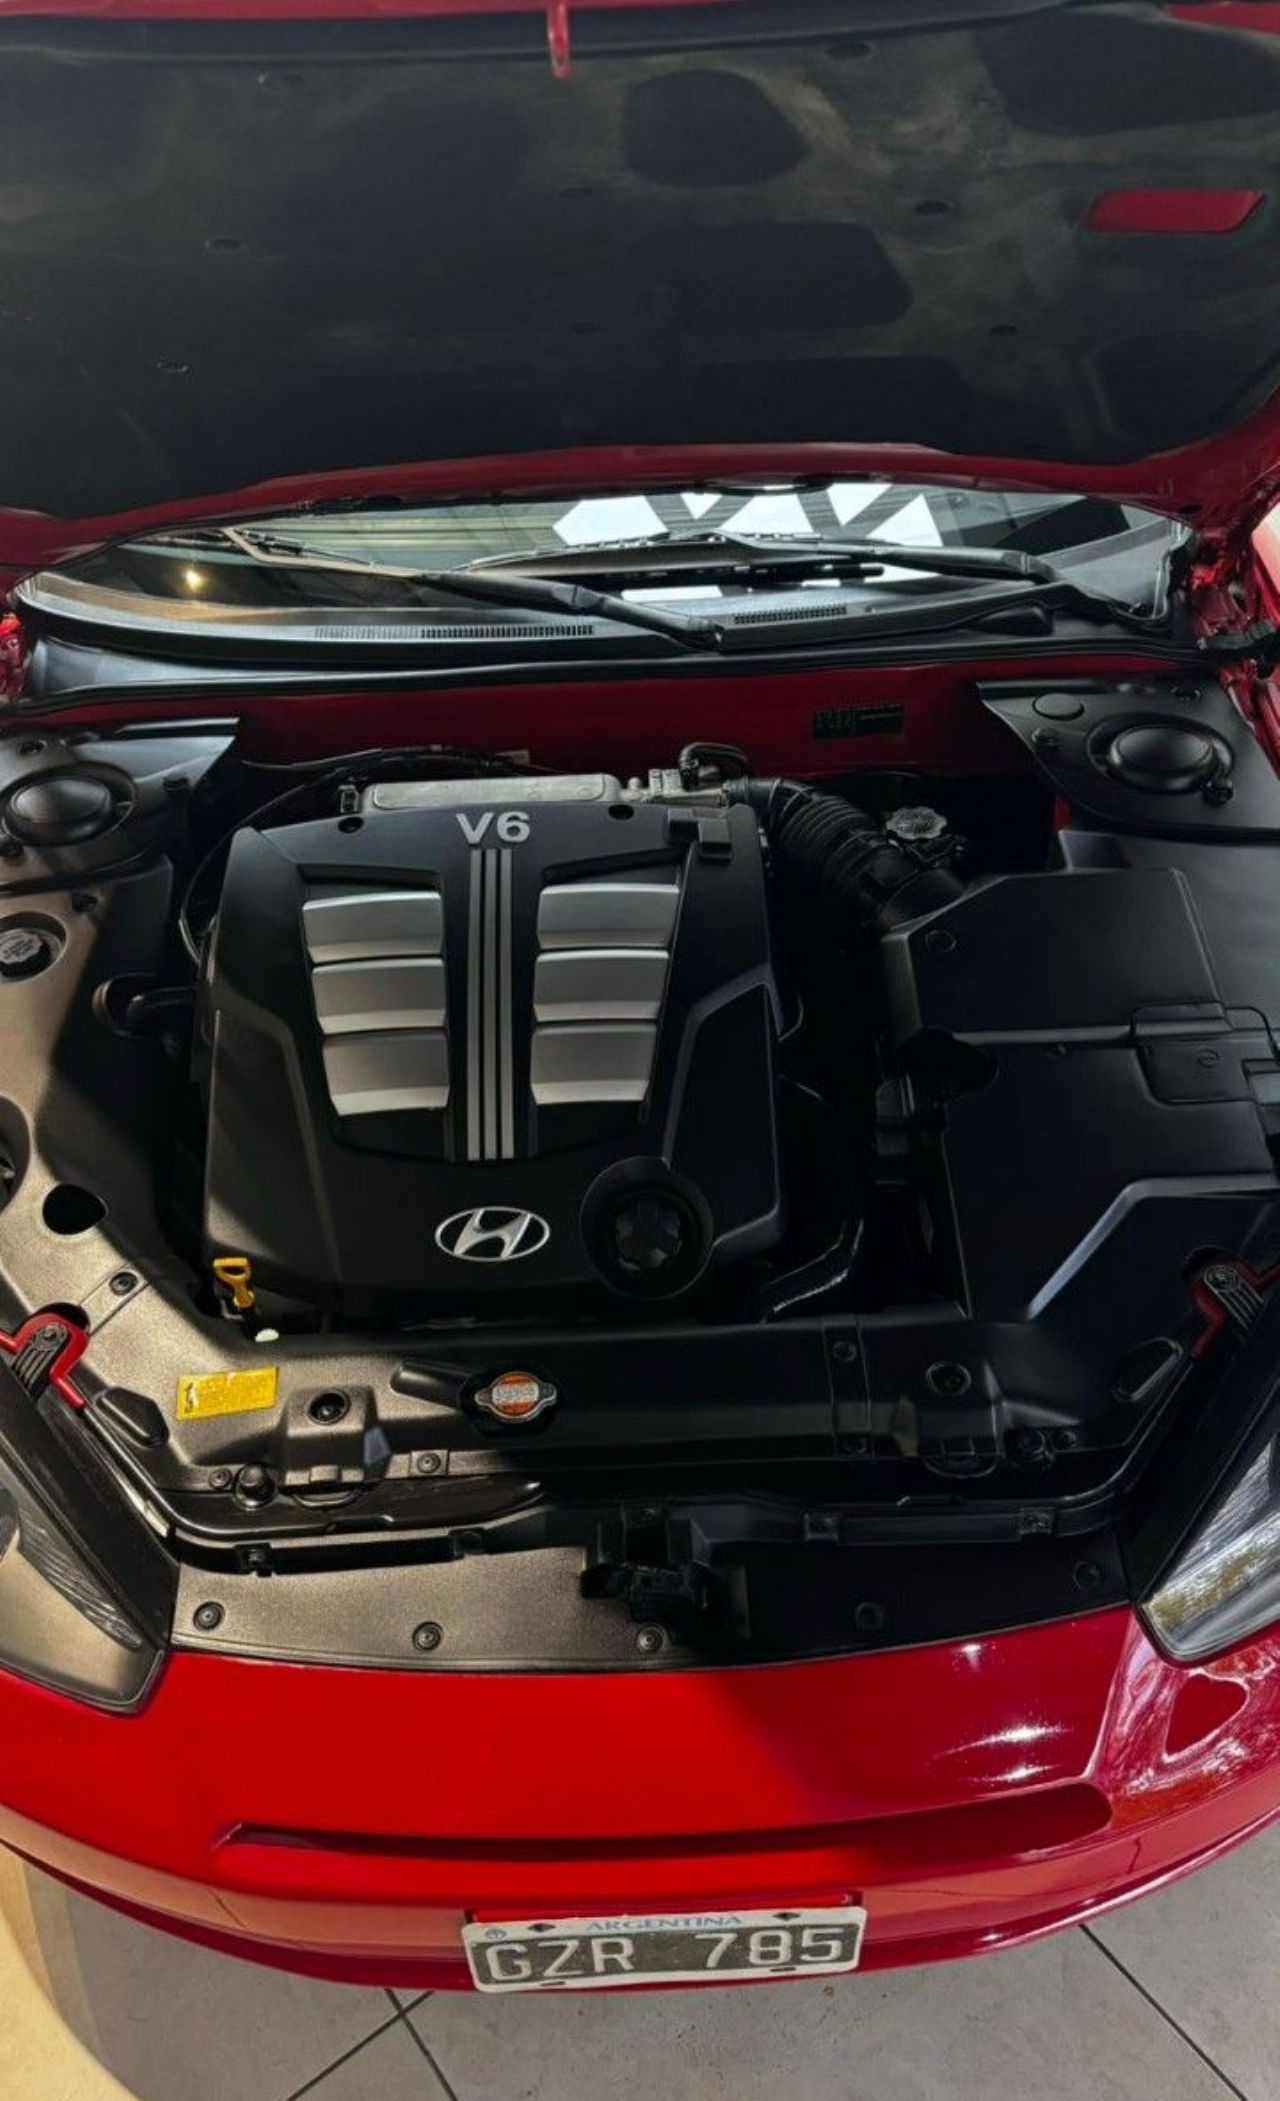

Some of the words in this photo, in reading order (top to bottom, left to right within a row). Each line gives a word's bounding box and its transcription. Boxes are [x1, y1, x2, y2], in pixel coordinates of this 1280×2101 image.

[456, 811, 530, 845] V6
[586, 1916, 743, 1932] ARGENTINA
[485, 1937, 635, 1981] GZR
[695, 1927, 844, 1969] 785
